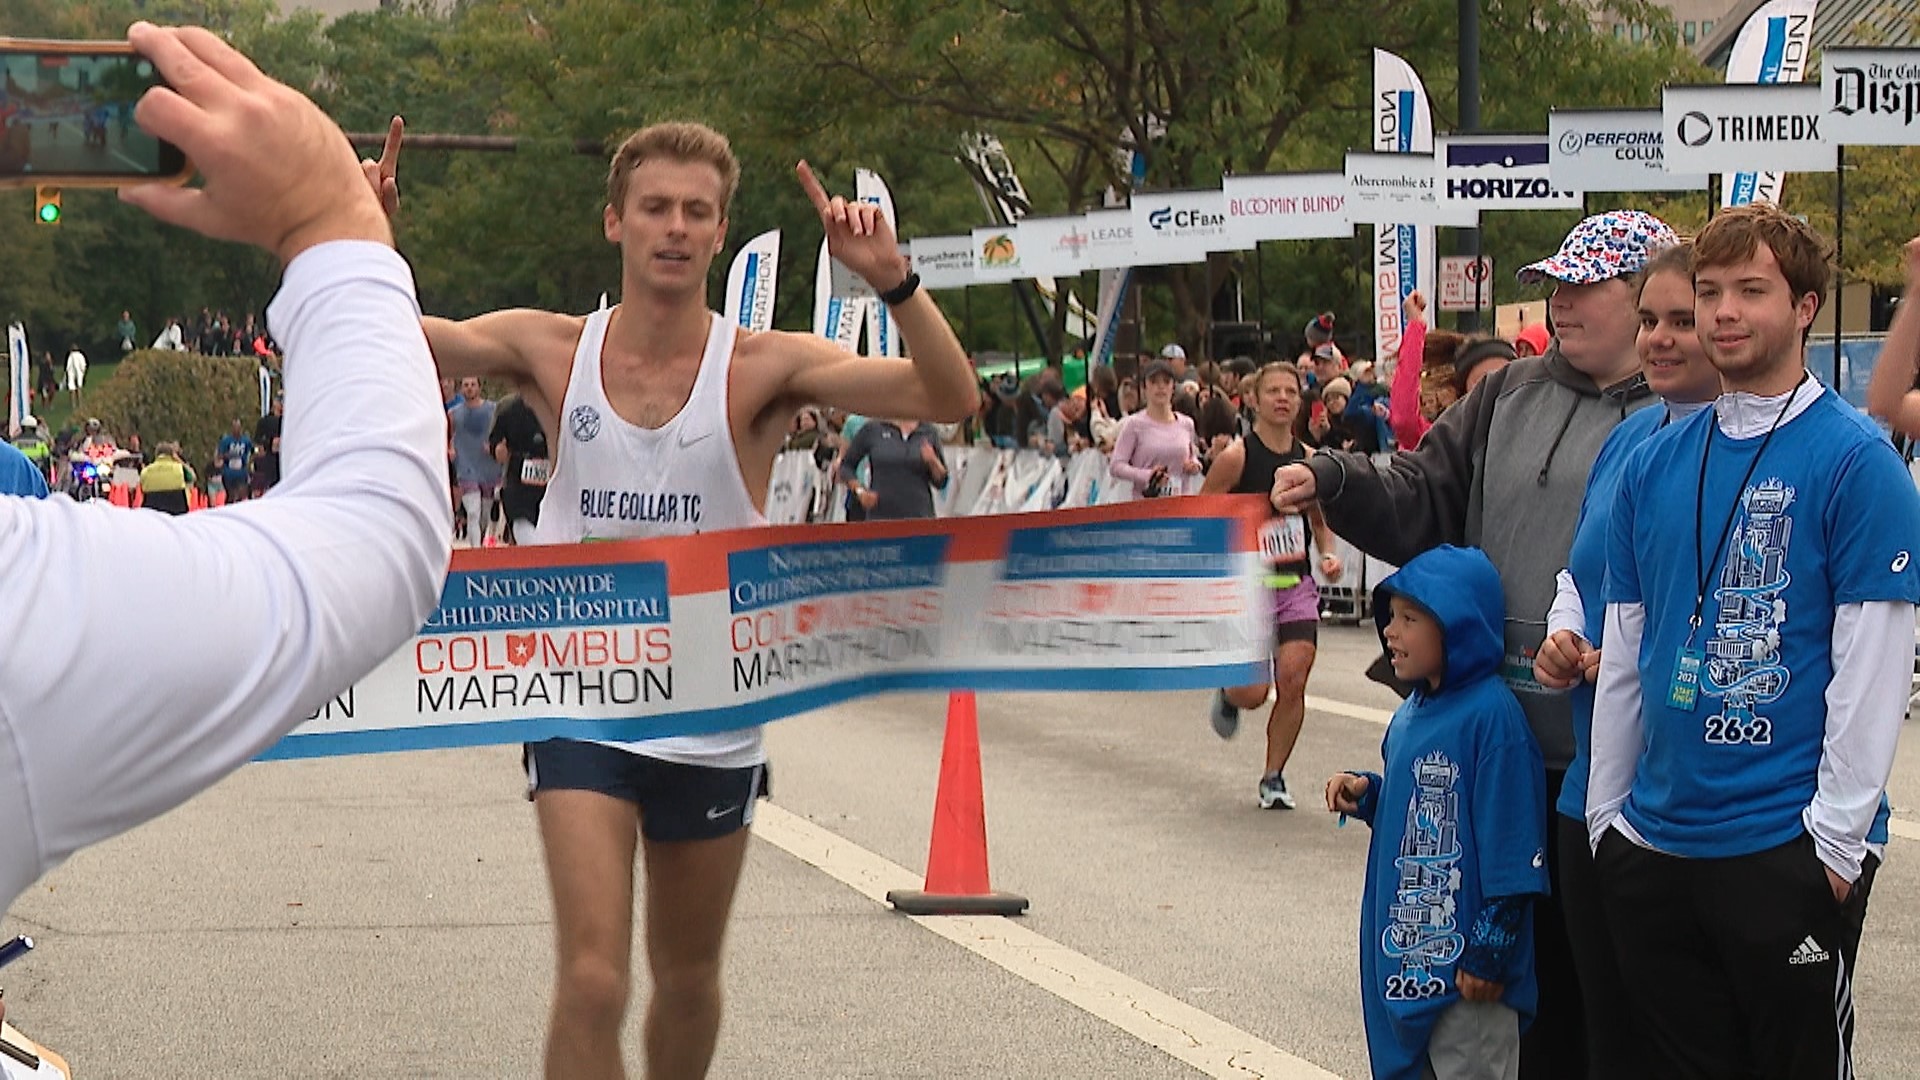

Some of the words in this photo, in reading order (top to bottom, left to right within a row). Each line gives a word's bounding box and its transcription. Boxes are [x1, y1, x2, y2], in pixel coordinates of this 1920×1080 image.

[1869, 63, 1892, 79] The
[1717, 115, 1820, 142] TRIMEDX
[1351, 174, 1417, 188] Abercrombie
[1419, 179, 1427, 188] &
[1447, 178, 1574, 199] HORIZO
[580, 489, 616, 518] BLUE
[619, 492, 678, 523] COLLAR
[682, 495, 701, 523] TC
[556, 595, 663, 621] HOSPITAL
[418, 666, 673, 712] MARATHON
[1789, 951, 1829, 964] adidas
